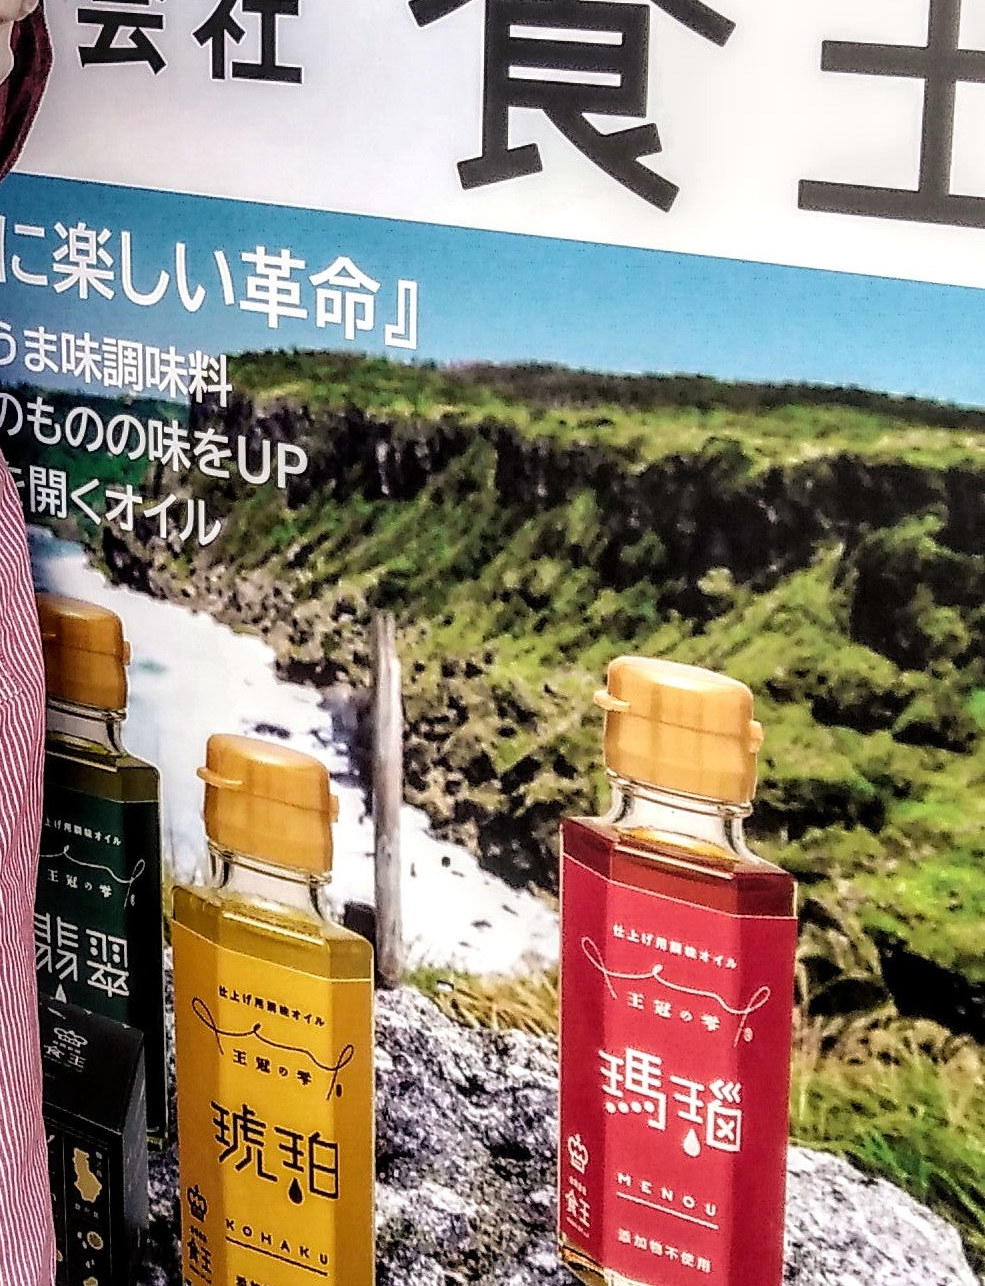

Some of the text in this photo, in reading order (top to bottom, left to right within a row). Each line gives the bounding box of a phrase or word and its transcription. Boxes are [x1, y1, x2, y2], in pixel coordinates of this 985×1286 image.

[599, 1047, 743, 1153] 瑪瑙
[210, 1102, 340, 1200] 琥珀
[617, 1172, 717, 1217] MENOU
[225, 1218, 328, 1265] KOHAKU
[617, 1227, 712, 1274] 添加物不使用
